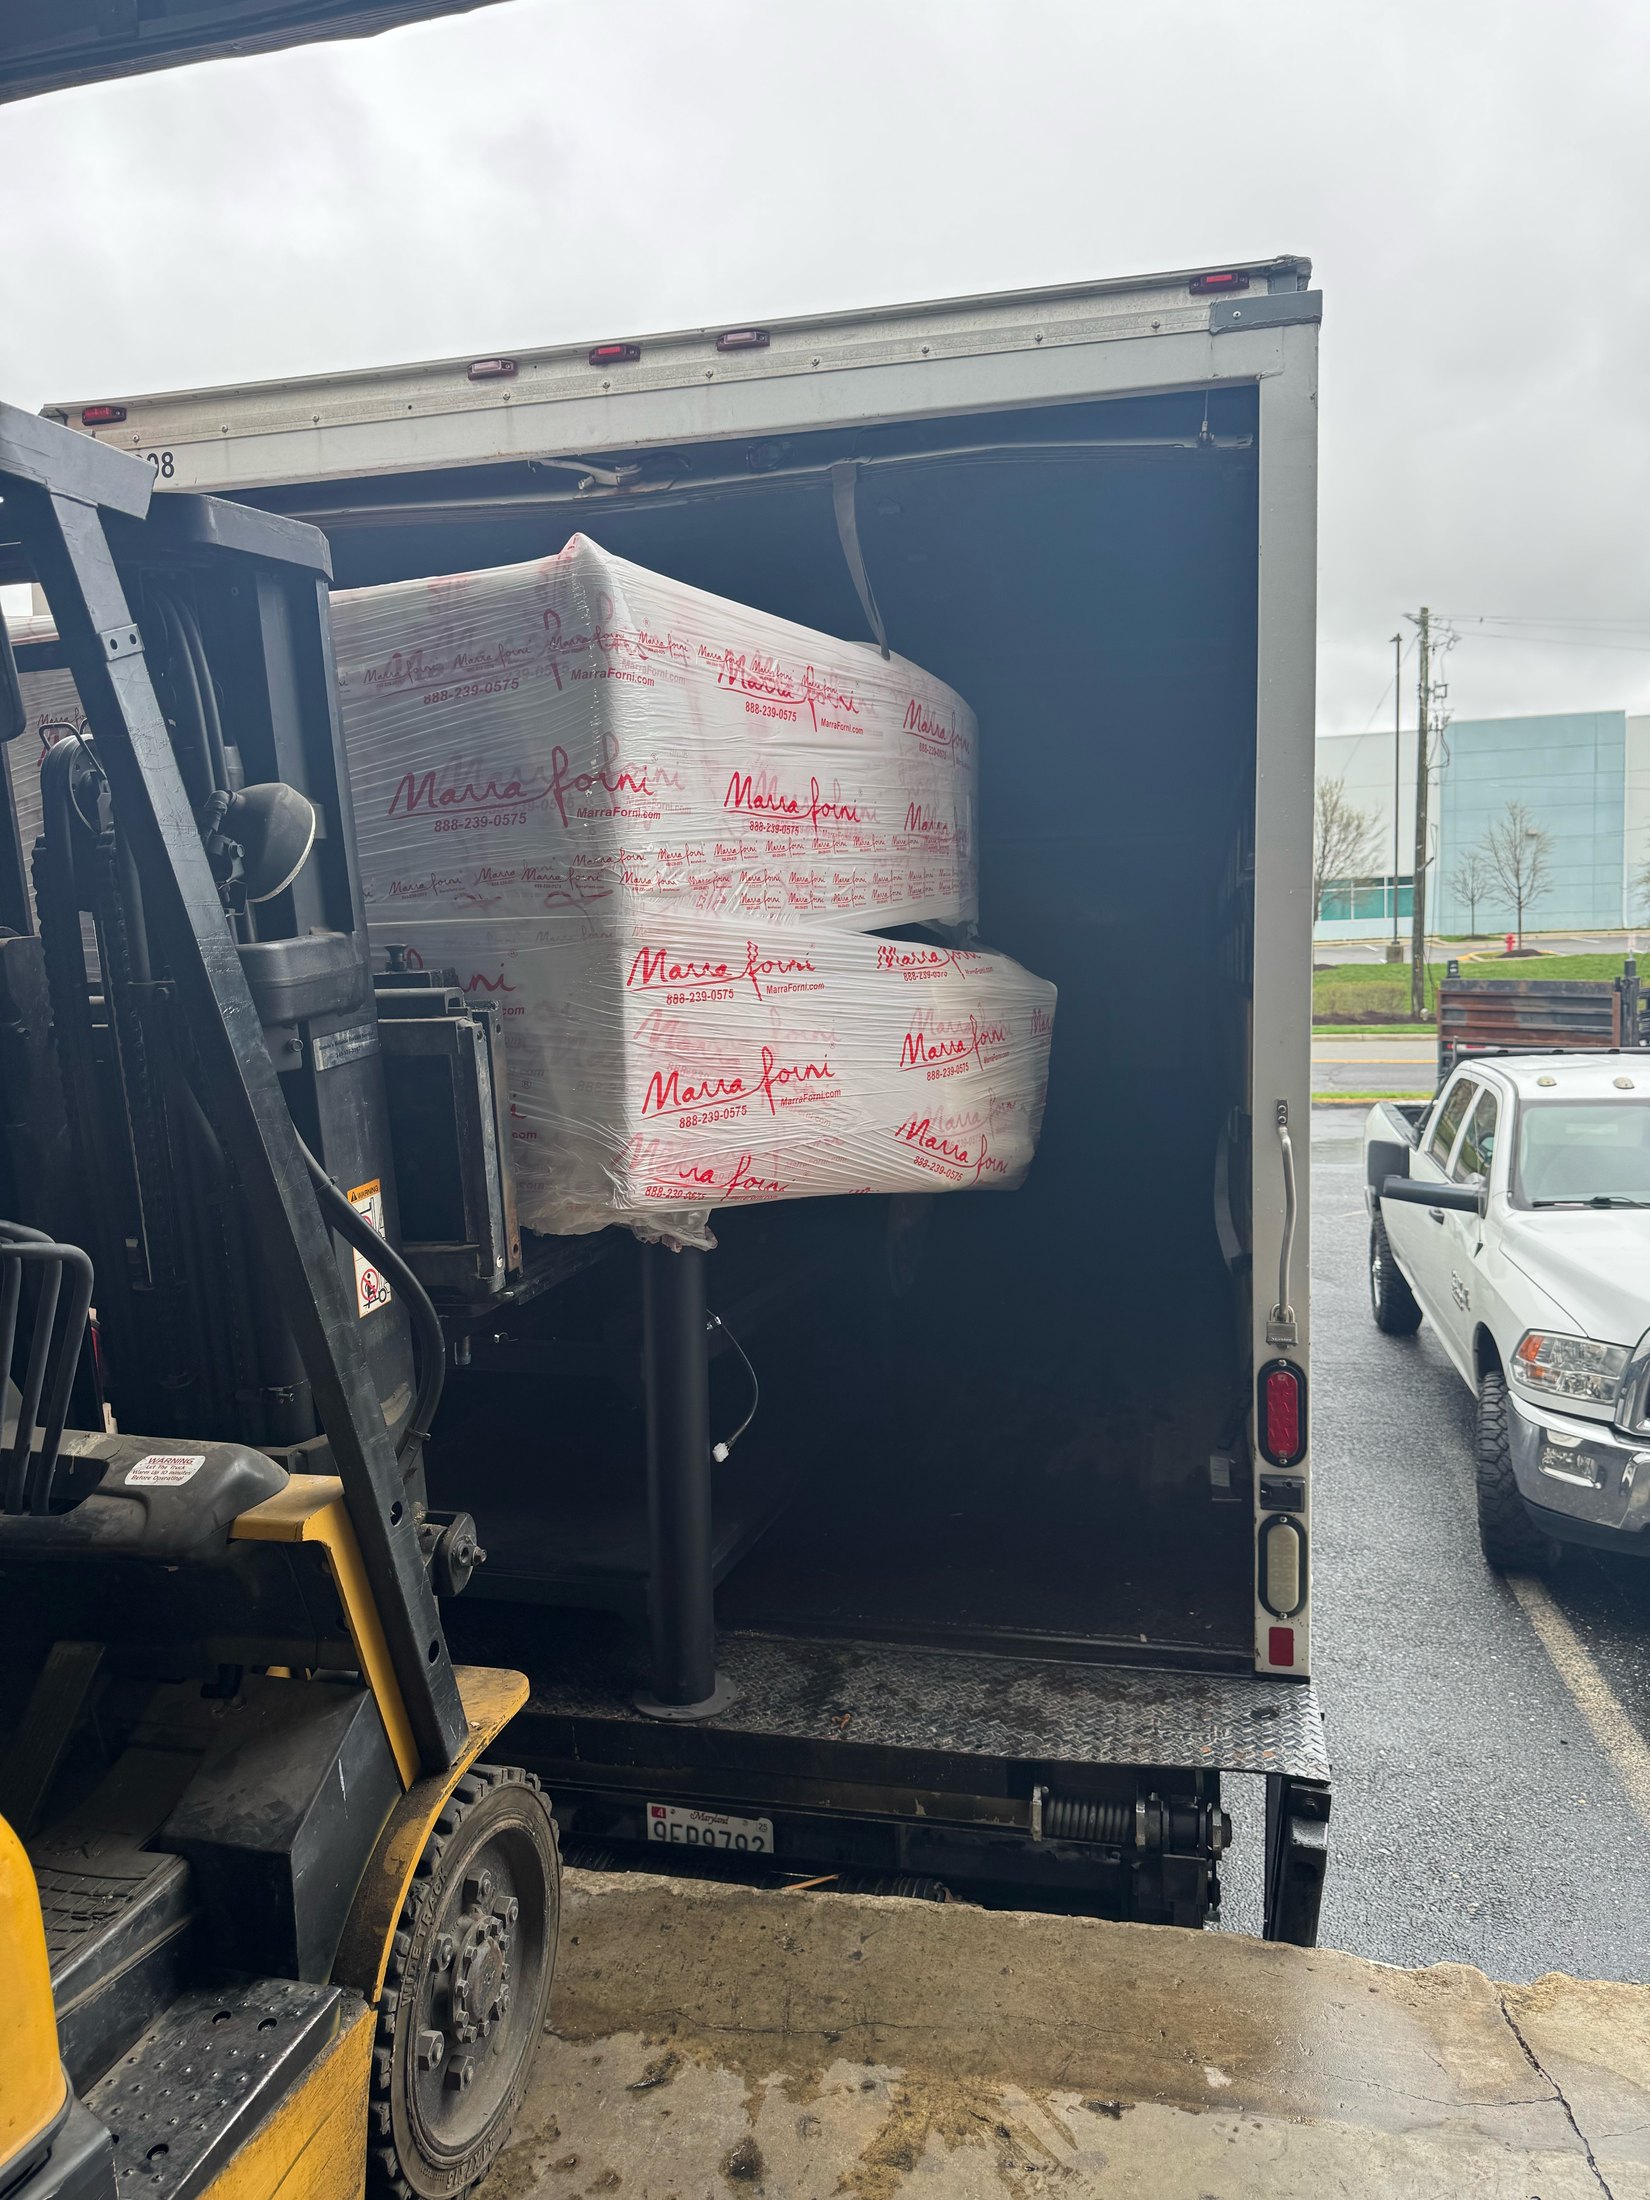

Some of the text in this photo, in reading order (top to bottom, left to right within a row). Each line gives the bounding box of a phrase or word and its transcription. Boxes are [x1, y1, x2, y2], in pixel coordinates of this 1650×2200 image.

[570, 667, 655, 687] MarraForni.com
[423, 677, 519, 705] 888-239-0575
[745, 701, 797, 722] 888-239-0575
[903, 699, 946, 740] Marra
[388, 770, 527, 815] Marra
[724, 771, 800, 813] Marra
[434, 812, 527, 832] 888-239-0575
[576, 806, 661, 820] MarraForni.com
[749, 820, 800, 836] 888-239-0575
[714, 843, 736, 857] Marra
[521, 868, 561, 882] Marra
[620, 871, 652, 886] Marra
[739, 871, 761, 884] Marra
[388, 881, 425, 896] Marra
[740, 892, 761, 905] Marra
[627, 946, 733, 986] Marra
[877, 945, 942, 969] Marra
[666, 988, 734, 1005] 888-239-0575
[766, 982, 825, 995] MarraForni.com
[900, 1032, 966, 1067] Marra
[926, 1062, 969, 1081] 888-239-0575
[641, 1071, 747, 1114] Marra
[780, 1088, 841, 1108] MarraForni.com
[679, 1105, 748, 1129] 888-239-0575
[895, 1118, 969, 1163] Marra
[913, 1155, 963, 1182] 888-239-0575
[357, 1184, 379, 1199] WARNING
[148, 1457, 195, 1465] WARNING
[690, 1811, 729, 1825] Maryland
[758, 1822, 768, 1832] 25
